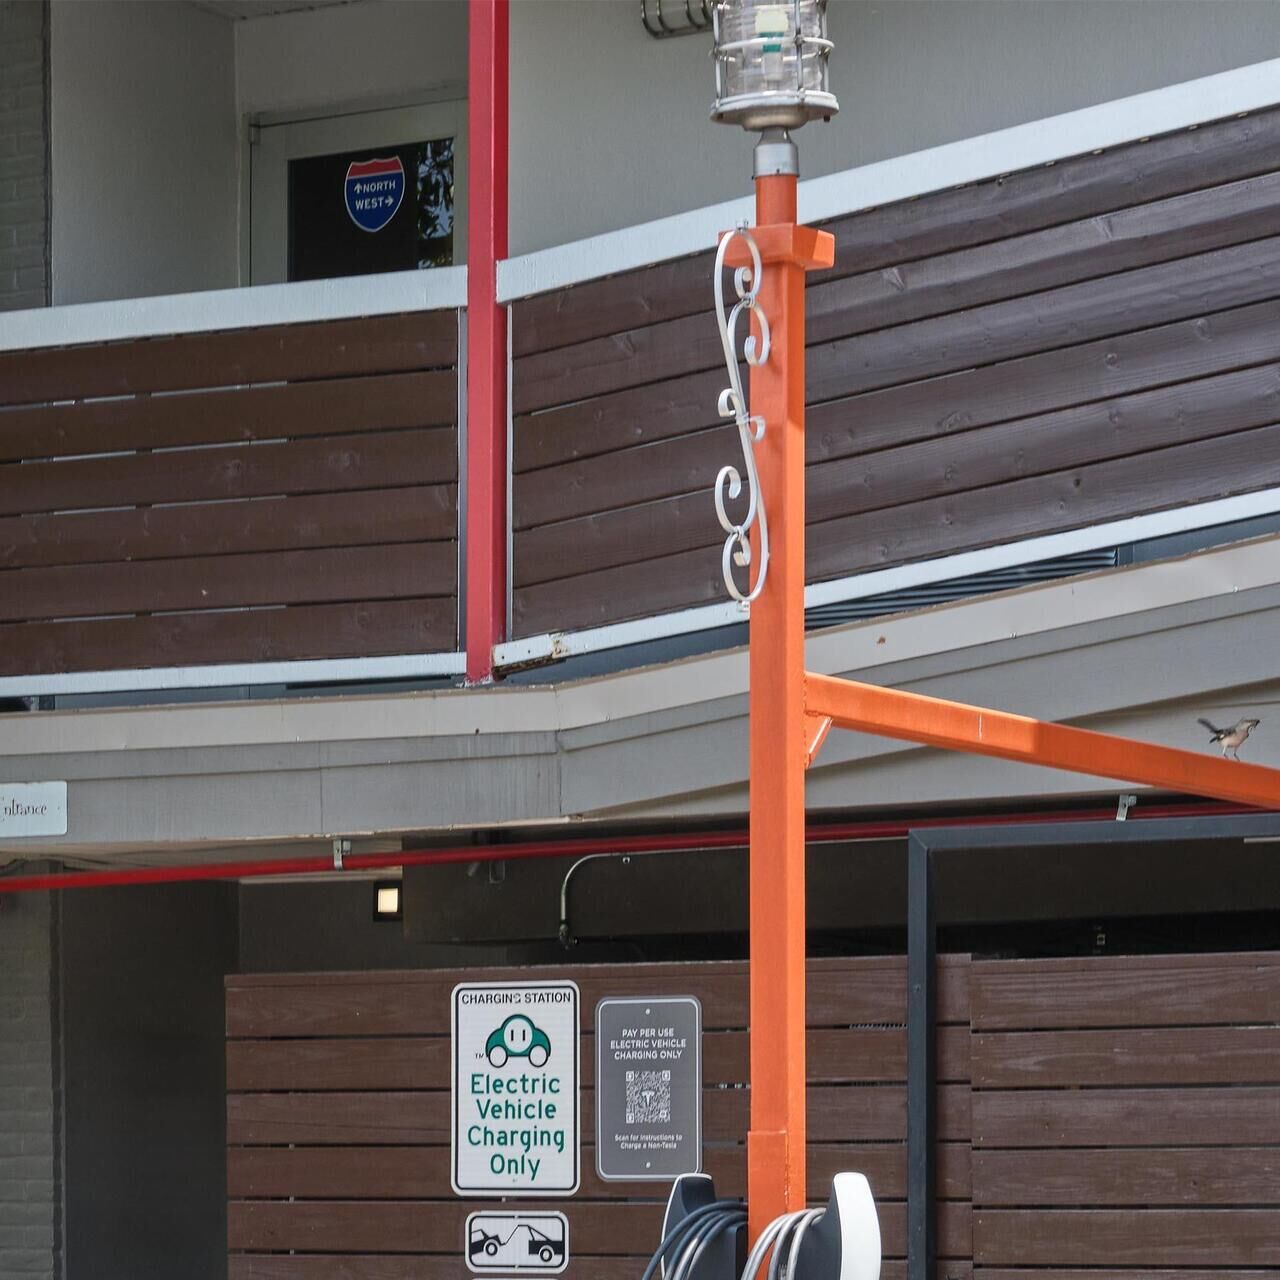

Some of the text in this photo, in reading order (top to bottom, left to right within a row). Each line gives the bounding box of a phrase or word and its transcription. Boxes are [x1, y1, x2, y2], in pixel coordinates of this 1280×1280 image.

[363, 180, 396, 192] NORTH
[355, 197, 384, 210] WEST
[462, 991, 571, 1005] CHARGING STATION
[622, 1027, 674, 1038] PAY PER USE
[610, 1039, 687, 1049] ELECTRIC VEHICLE
[614, 1050, 683, 1060] CHARGING ONLY
[471, 1073, 560, 1094] Electric
[476, 1099, 556, 1120] Vehicle
[467, 1125, 565, 1153] Charging
[620, 1142, 641, 1150] Charge
[490, 1154, 540, 1181] Only
